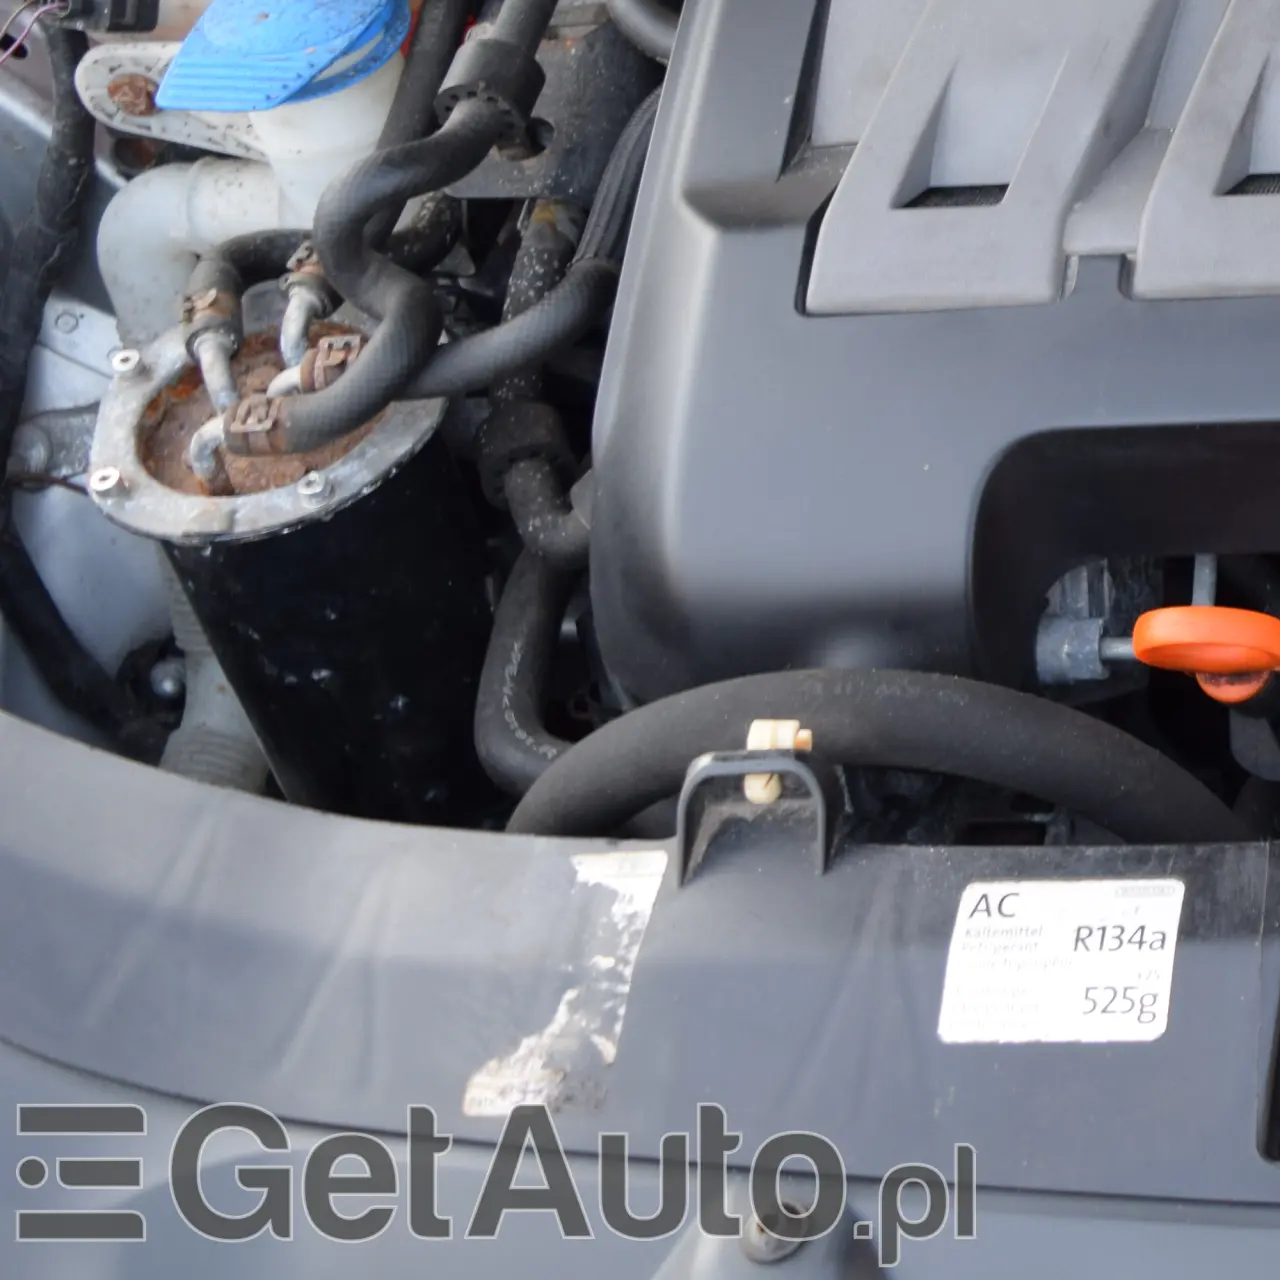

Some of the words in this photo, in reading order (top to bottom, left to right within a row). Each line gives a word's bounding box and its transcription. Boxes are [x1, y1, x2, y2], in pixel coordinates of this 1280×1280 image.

[968, 892, 1020, 919] AC
[1073, 923, 1168, 953] R134a
[1082, 986, 1159, 1025] 525g
